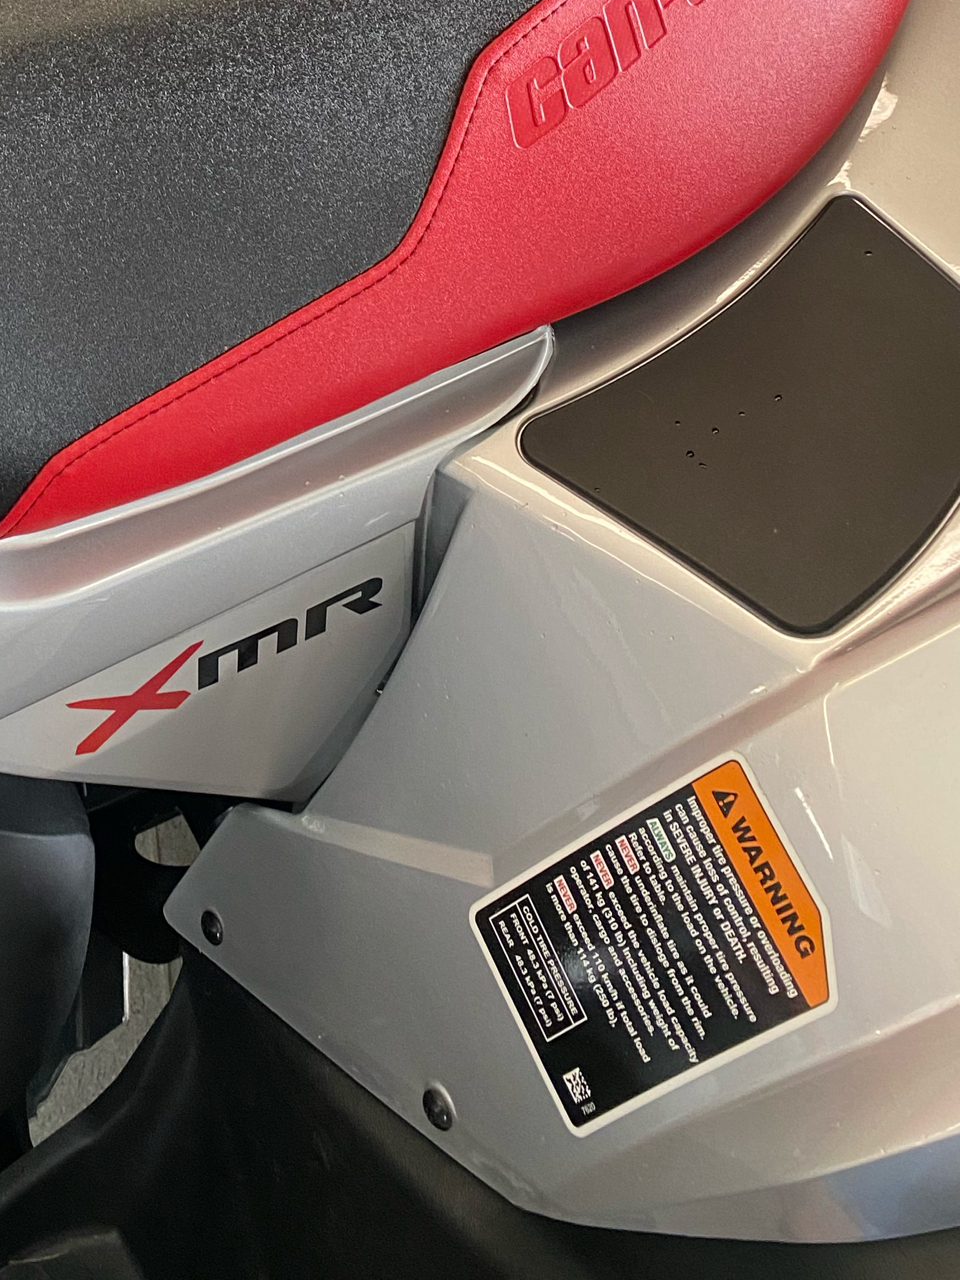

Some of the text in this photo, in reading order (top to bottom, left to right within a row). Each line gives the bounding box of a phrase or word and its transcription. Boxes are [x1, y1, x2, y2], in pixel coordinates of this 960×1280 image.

[510, 912, 529, 944] FRONT
[536, 969, 548, 989] kPa
[545, 882, 553, 893] is
[550, 894, 566, 921] more
[563, 921, 578, 946] than
[576, 947, 590, 967] 114
[585, 967, 596, 983] kg
[592, 983, 609, 1007] (250
[605, 843, 623, 875] cause
[620, 875, 632, 893] the
[629, 893, 642, 913] tire
[639, 913, 648, 926] to
[666, 968, 684, 996] from
[681, 995, 694, 1015] the
[617, 838, 712, 1018] NEVER underinflate tire as it could
[628, 831, 665, 905] Refer to table.
[638, 826, 738, 1019] according to the load on the vehicle.
[649, 821, 756, 1022] ALWAYS maintain proper tire pressure
[662, 808, 746, 964] in SEVERE INJURY or DEATH.
[674, 803, 779, 994] can cause loss of control, resulting
[686, 795, 798, 998] Improper tire pressure or overloading
[731, 815, 815, 959] WARNING
[498, 920, 514, 947] REAR
[524, 975, 536, 995] kPa
[522, 905, 578, 1015] COLD TIRE PRESSURE
[556, 878, 651, 1062] NEVER exceed 110 km/h if total load
[580, 859, 590, 871] of
[586, 871, 599, 890] 141
[595, 891, 605, 907] kg
[601, 907, 618, 930] (310
[648, 998, 671, 1038] weight
[667, 1037, 680, 1050] of
[592, 853, 699, 1062] NEVER exceed the vehicle load capacity
[592, 913, 610, 944] cargo
[607, 945, 623, 967] and
[618, 967, 654, 1036] accessories.
